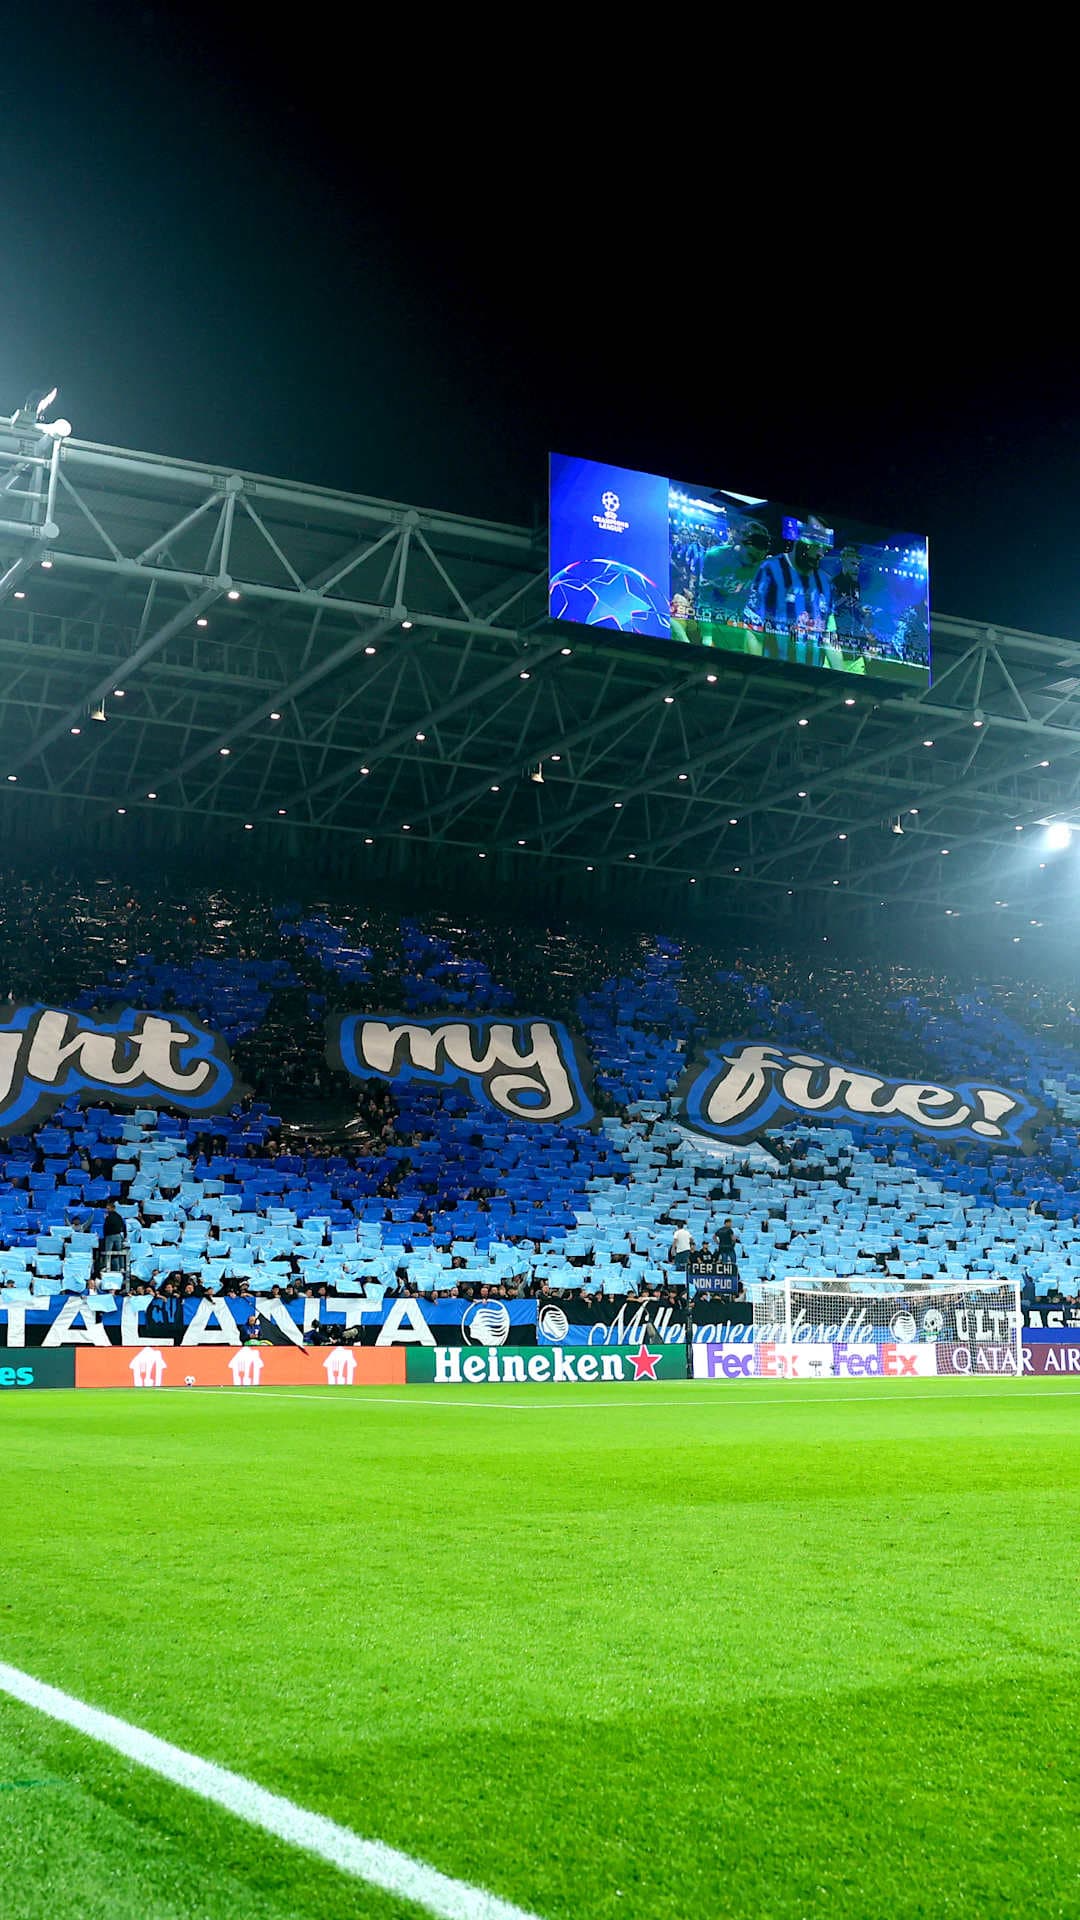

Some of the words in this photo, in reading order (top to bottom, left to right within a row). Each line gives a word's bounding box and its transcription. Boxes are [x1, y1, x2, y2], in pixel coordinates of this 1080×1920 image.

[362, 1022, 574, 1119] my
[707, 1046, 1016, 1136] fire!
[692, 1263, 713, 1274] PER
[716, 1263, 733, 1275] CHI
[693, 1278, 712, 1289] NON
[433, 1347, 625, 1383] Heineken
[706, 1343, 799, 1378] FedEx
[832, 1343, 919, 1376] FedEx
[952, 1347, 1035, 1375] QATAR
